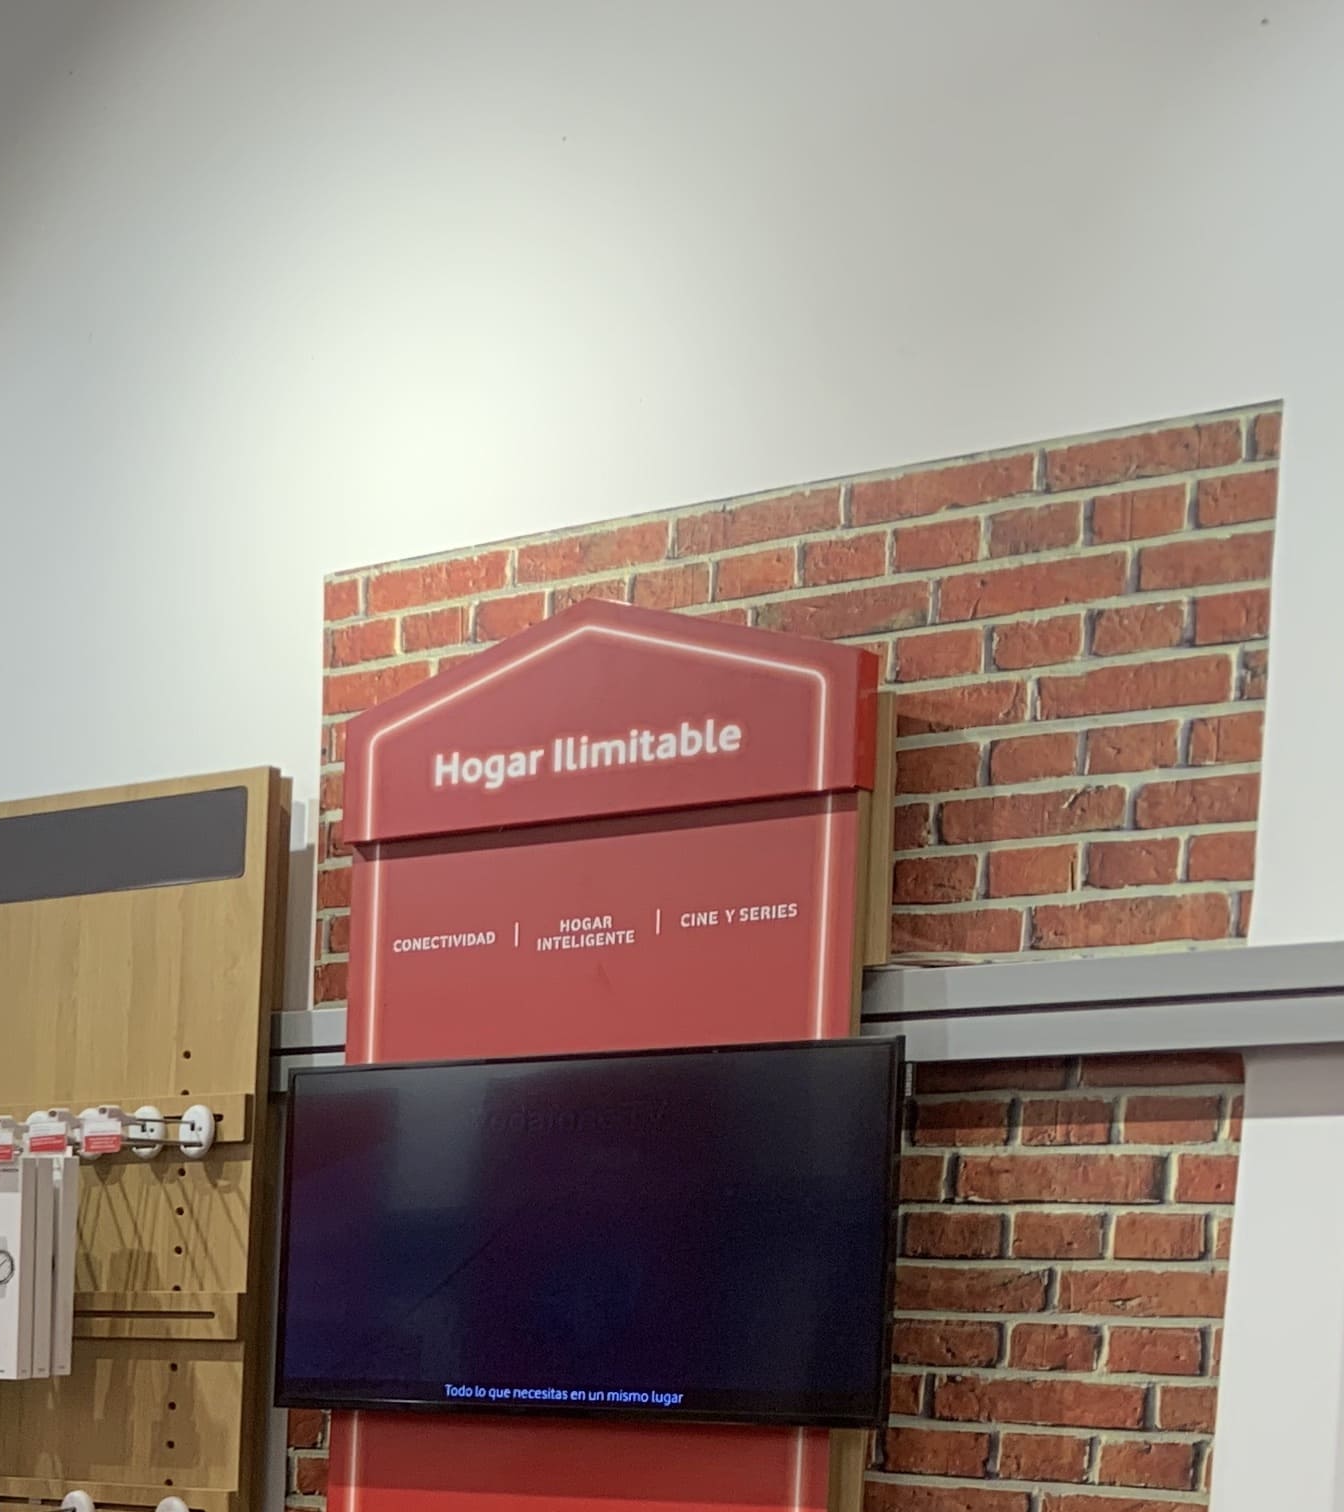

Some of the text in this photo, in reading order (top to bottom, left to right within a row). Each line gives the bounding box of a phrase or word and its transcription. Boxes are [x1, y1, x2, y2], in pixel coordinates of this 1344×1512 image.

[434, 719, 743, 790] Hogar Ilimitable
[559, 915, 613, 933] HOGAR
[680, 903, 798, 928] CINE Y SERIES
[393, 931, 496, 952] CONECTIVIDAD
[536, 929, 635, 951] INTELIGENTE
[445, 1384, 684, 1407] Todo lo que necesitas en un mismo lugar
